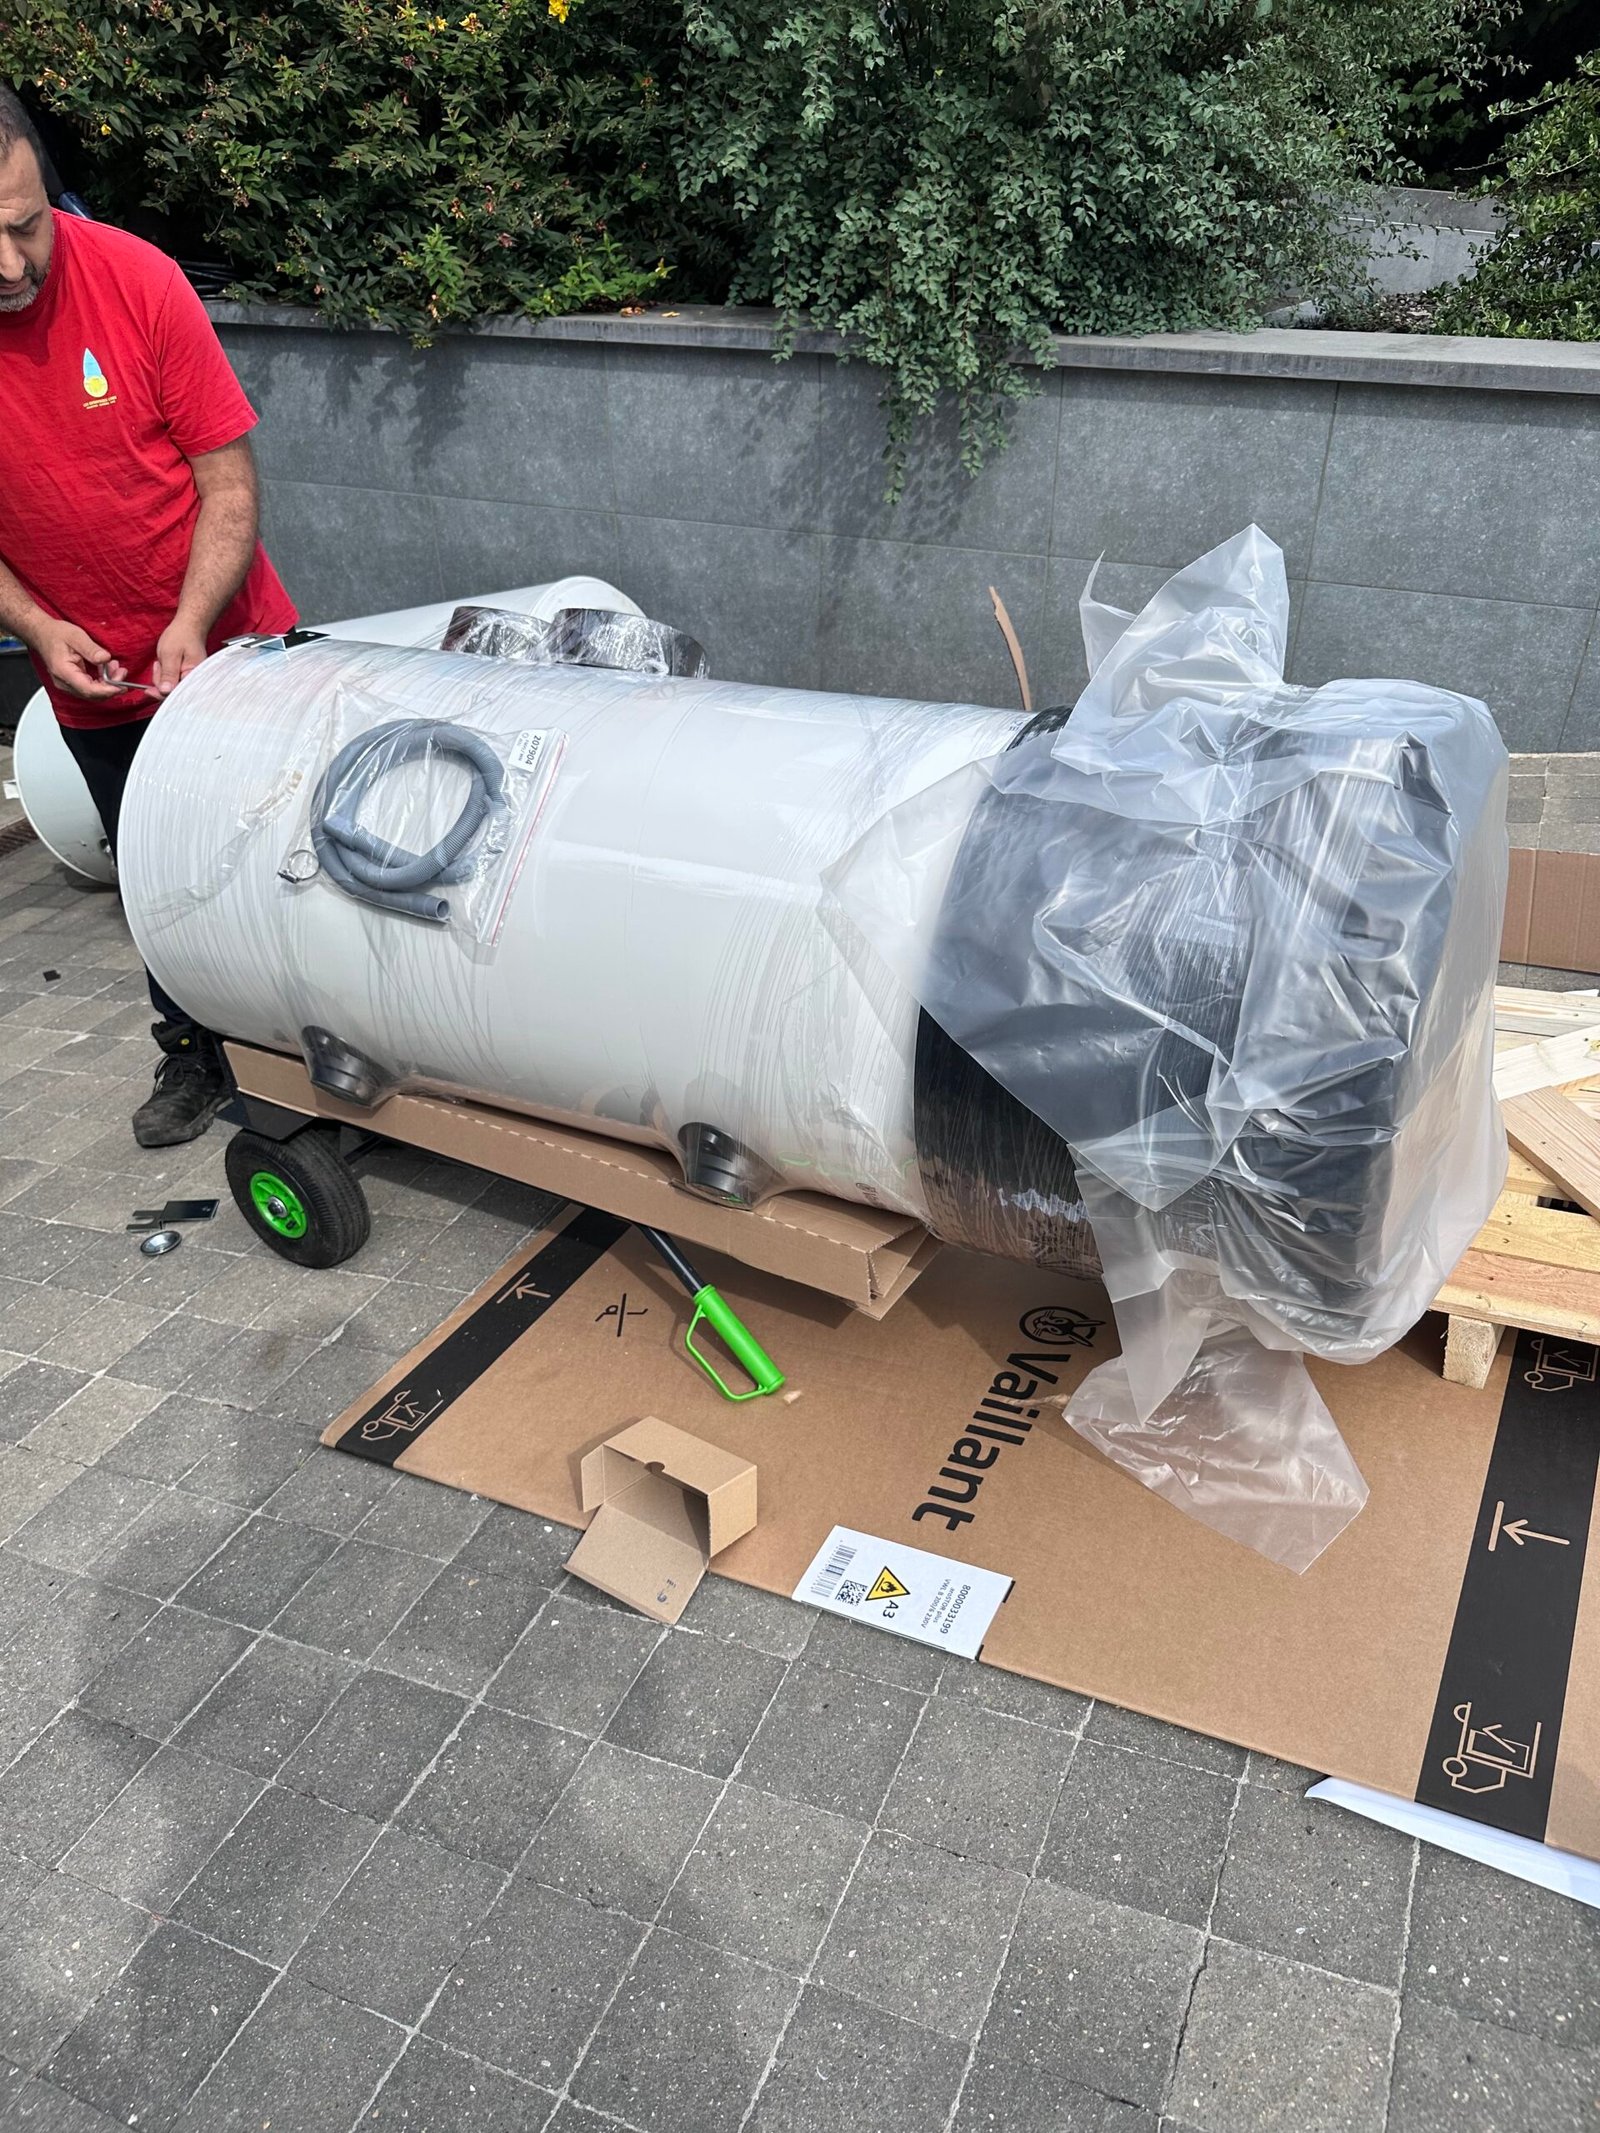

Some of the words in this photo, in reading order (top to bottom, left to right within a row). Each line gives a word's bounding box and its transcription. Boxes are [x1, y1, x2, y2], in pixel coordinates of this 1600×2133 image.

[525, 734, 542, 765] 207904
[911, 1353, 1072, 1531] Vaillant
[939, 1578, 952, 1591] VWL
[882, 1599, 900, 1619] A3
[920, 1612, 933, 1629] 230V
[940, 1584, 971, 1634] 8000033199
